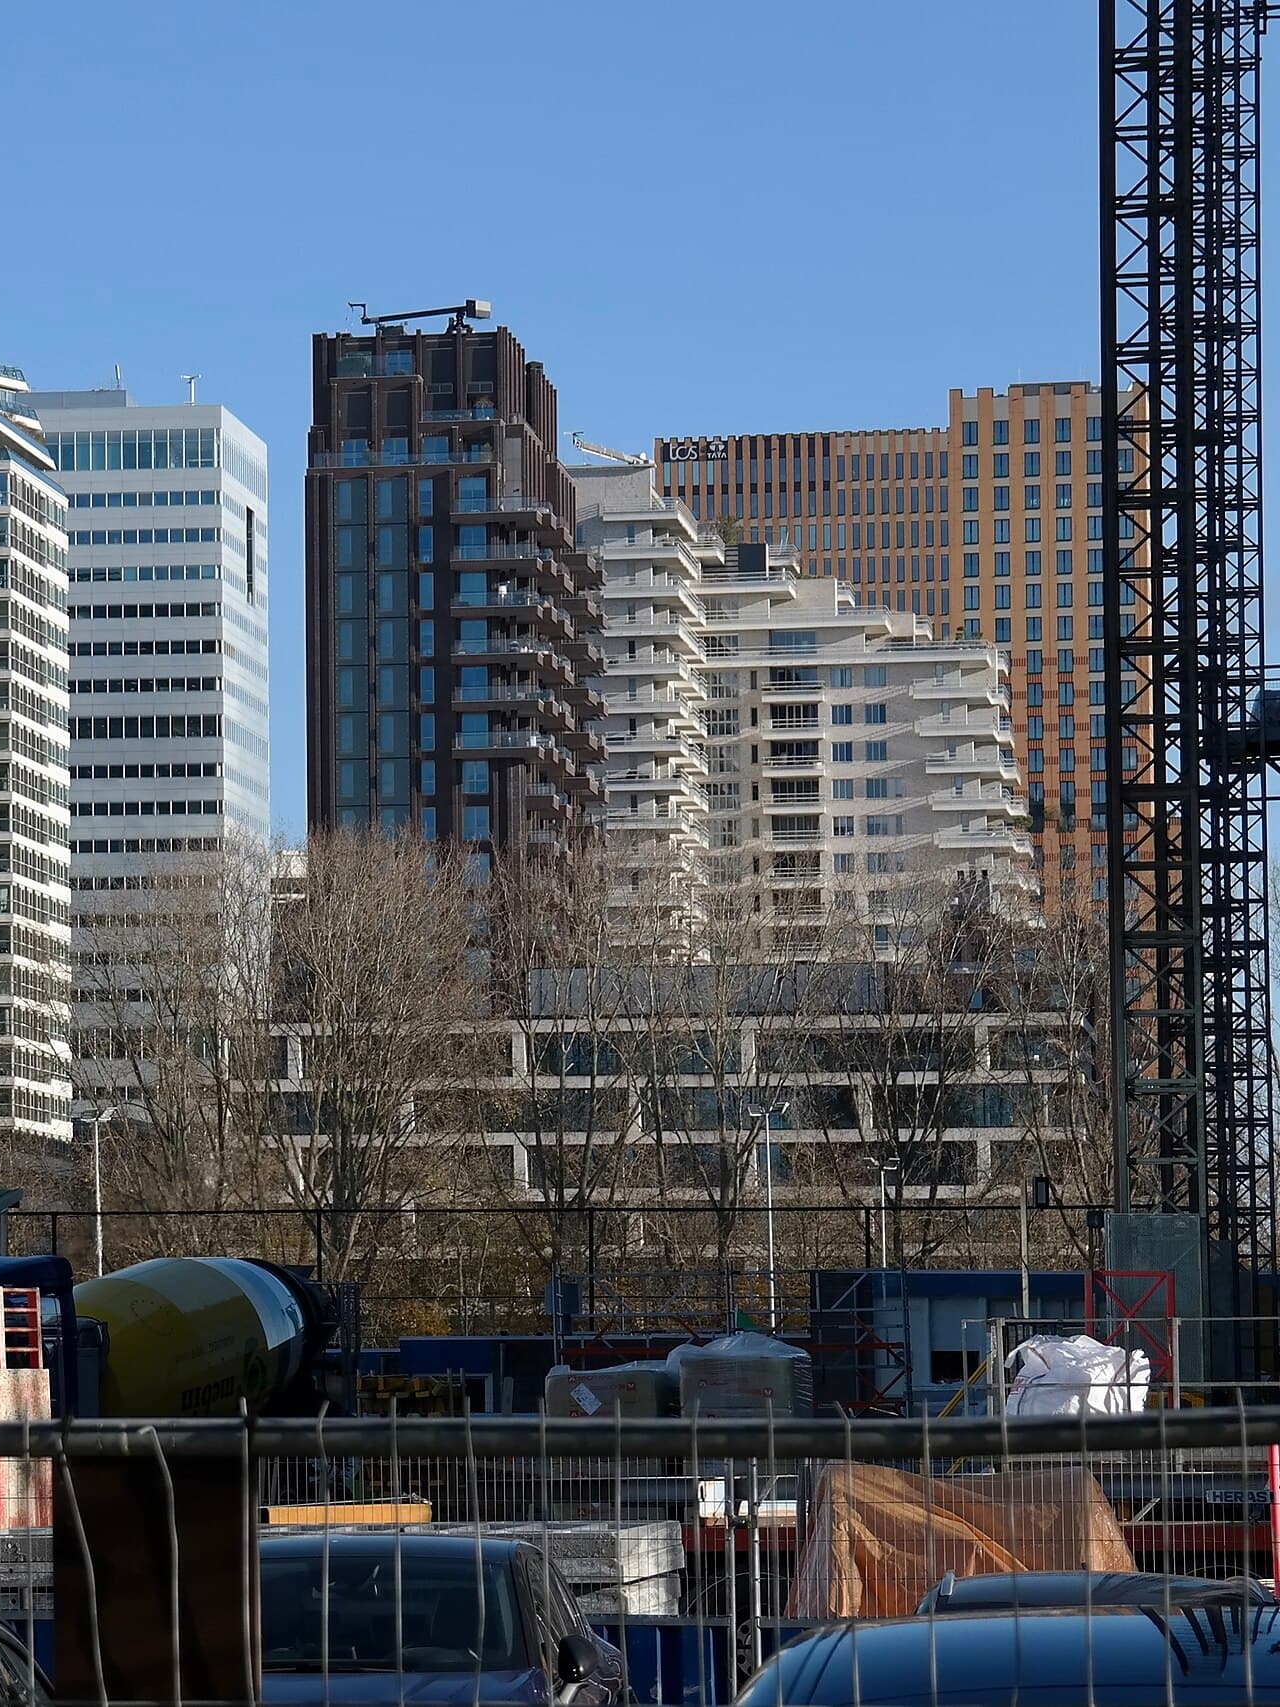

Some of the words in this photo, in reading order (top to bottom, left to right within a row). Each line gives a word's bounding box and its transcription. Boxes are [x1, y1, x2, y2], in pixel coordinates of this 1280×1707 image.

[669, 443, 698, 461] tcs
[182, 1376, 235, 1415] mebin
[1212, 1491, 1268, 1503] HERAS
